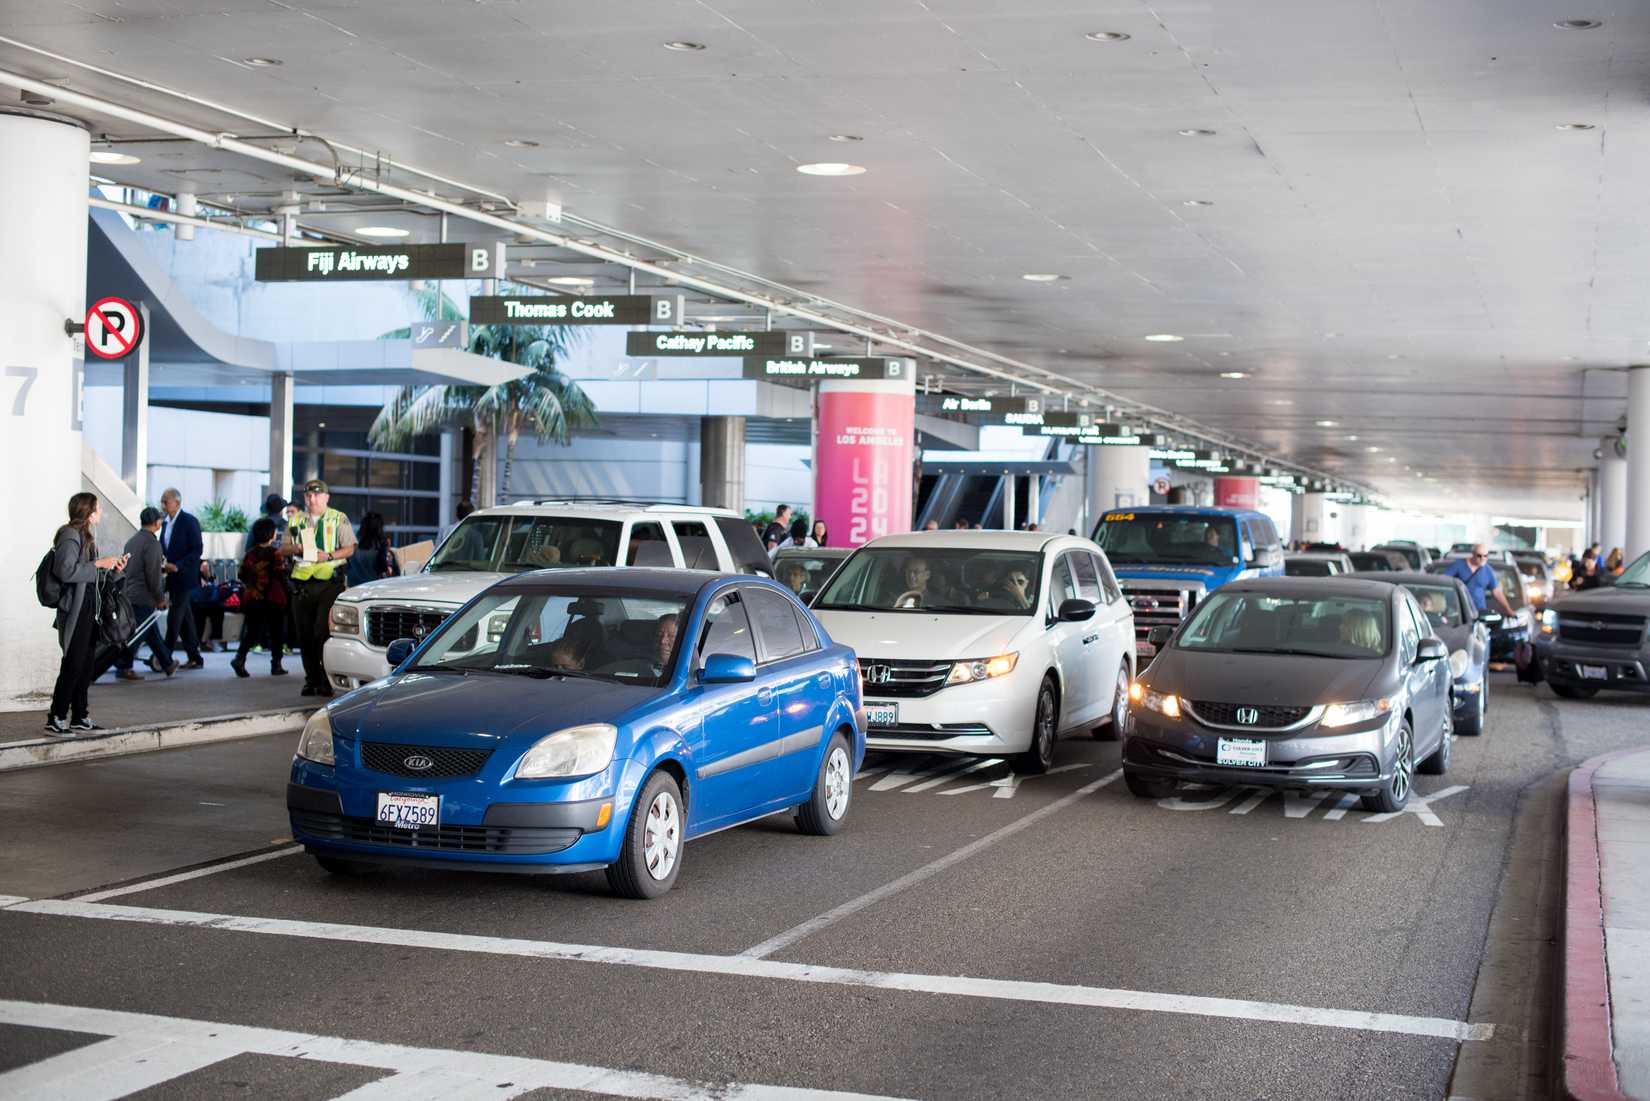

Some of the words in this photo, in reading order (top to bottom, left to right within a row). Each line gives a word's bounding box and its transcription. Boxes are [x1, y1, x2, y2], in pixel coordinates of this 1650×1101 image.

[307, 251, 334, 275] Fiji
[338, 251, 410, 274] Airways
[471, 249, 489, 272] B
[504, 301, 567, 318] Thomas
[571, 301, 614, 318] Cook
[657, 301, 672, 318] B
[656, 335, 705, 352] Cathay
[707, 335, 755, 351] Pacific
[790, 336, 804, 353] B
[766, 361, 806, 374] British
[808, 361, 859, 376] Airways
[889, 362, 901, 376] B
[5, 366, 38, 416] 7
[943, 398, 959, 410] Air
[1028, 400, 1040, 412] B
[836, 435, 856, 445] LOS
[859, 436, 903, 446] ANGELES
[866, 711, 894, 722] WJ889
[408, 758, 428, 767] KIA
[394, 820, 421, 830] Metro
